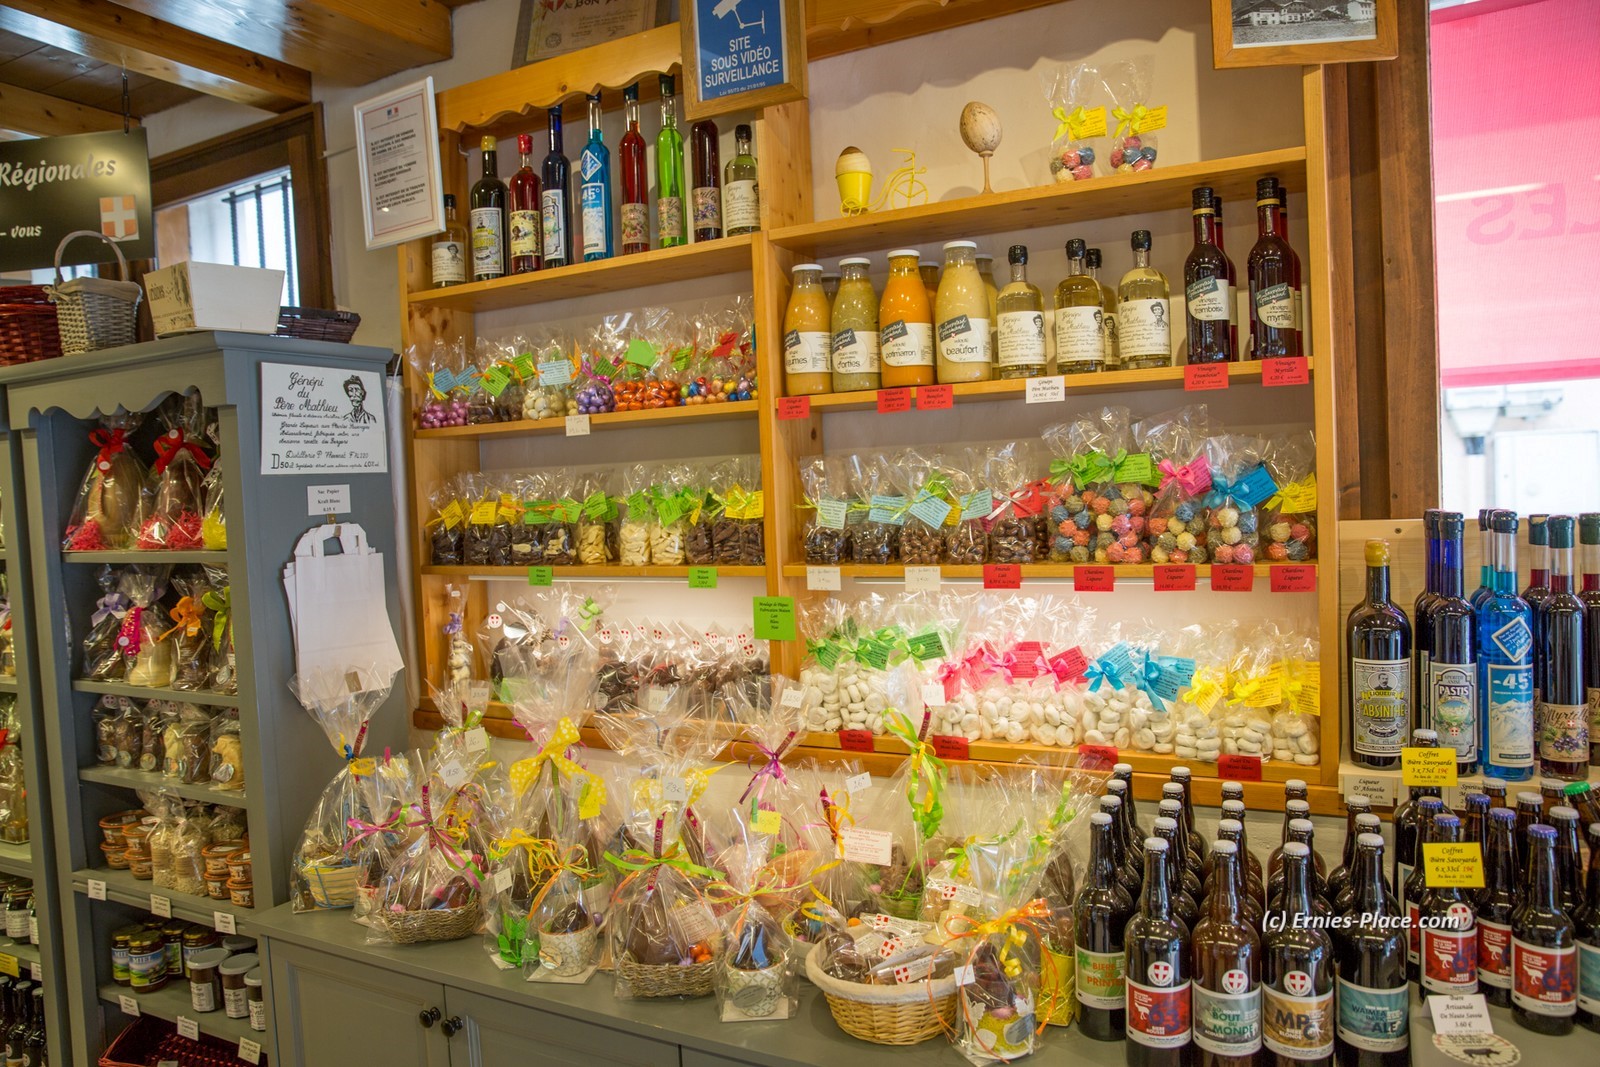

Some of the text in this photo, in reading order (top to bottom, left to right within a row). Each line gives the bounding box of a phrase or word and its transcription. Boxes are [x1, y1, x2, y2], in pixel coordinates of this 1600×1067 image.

[729, 36, 750, 52] SITE
[711, 45, 771, 71] SOUS VIDÉO
[705, 60, 779, 88] SURVEILLANCE
[0, 153, 117, 191] Régionales
[11, 225, 42, 238] vous
[946, 345, 979, 356] beaufort
[288, 372, 324, 391] Génépi
[297, 388, 309, 398] du
[273, 397, 338, 413] Père Mathieu
[1439, 686, 1469, 696] PASTIS
[1418, 751, 1439, 759] Coffret
[1359, 778, 1380, 786] Liqueur
[1441, 847, 1463, 855] Coffret
[1446, 856, 1478, 864] Savoyarde
[132, 956, 151, 964] MIEL
[1212, 1011, 1241, 1022] BOUT
[1213, 1024, 1253, 1035] MONDE
[1372, 1021, 1397, 1033] ALE
